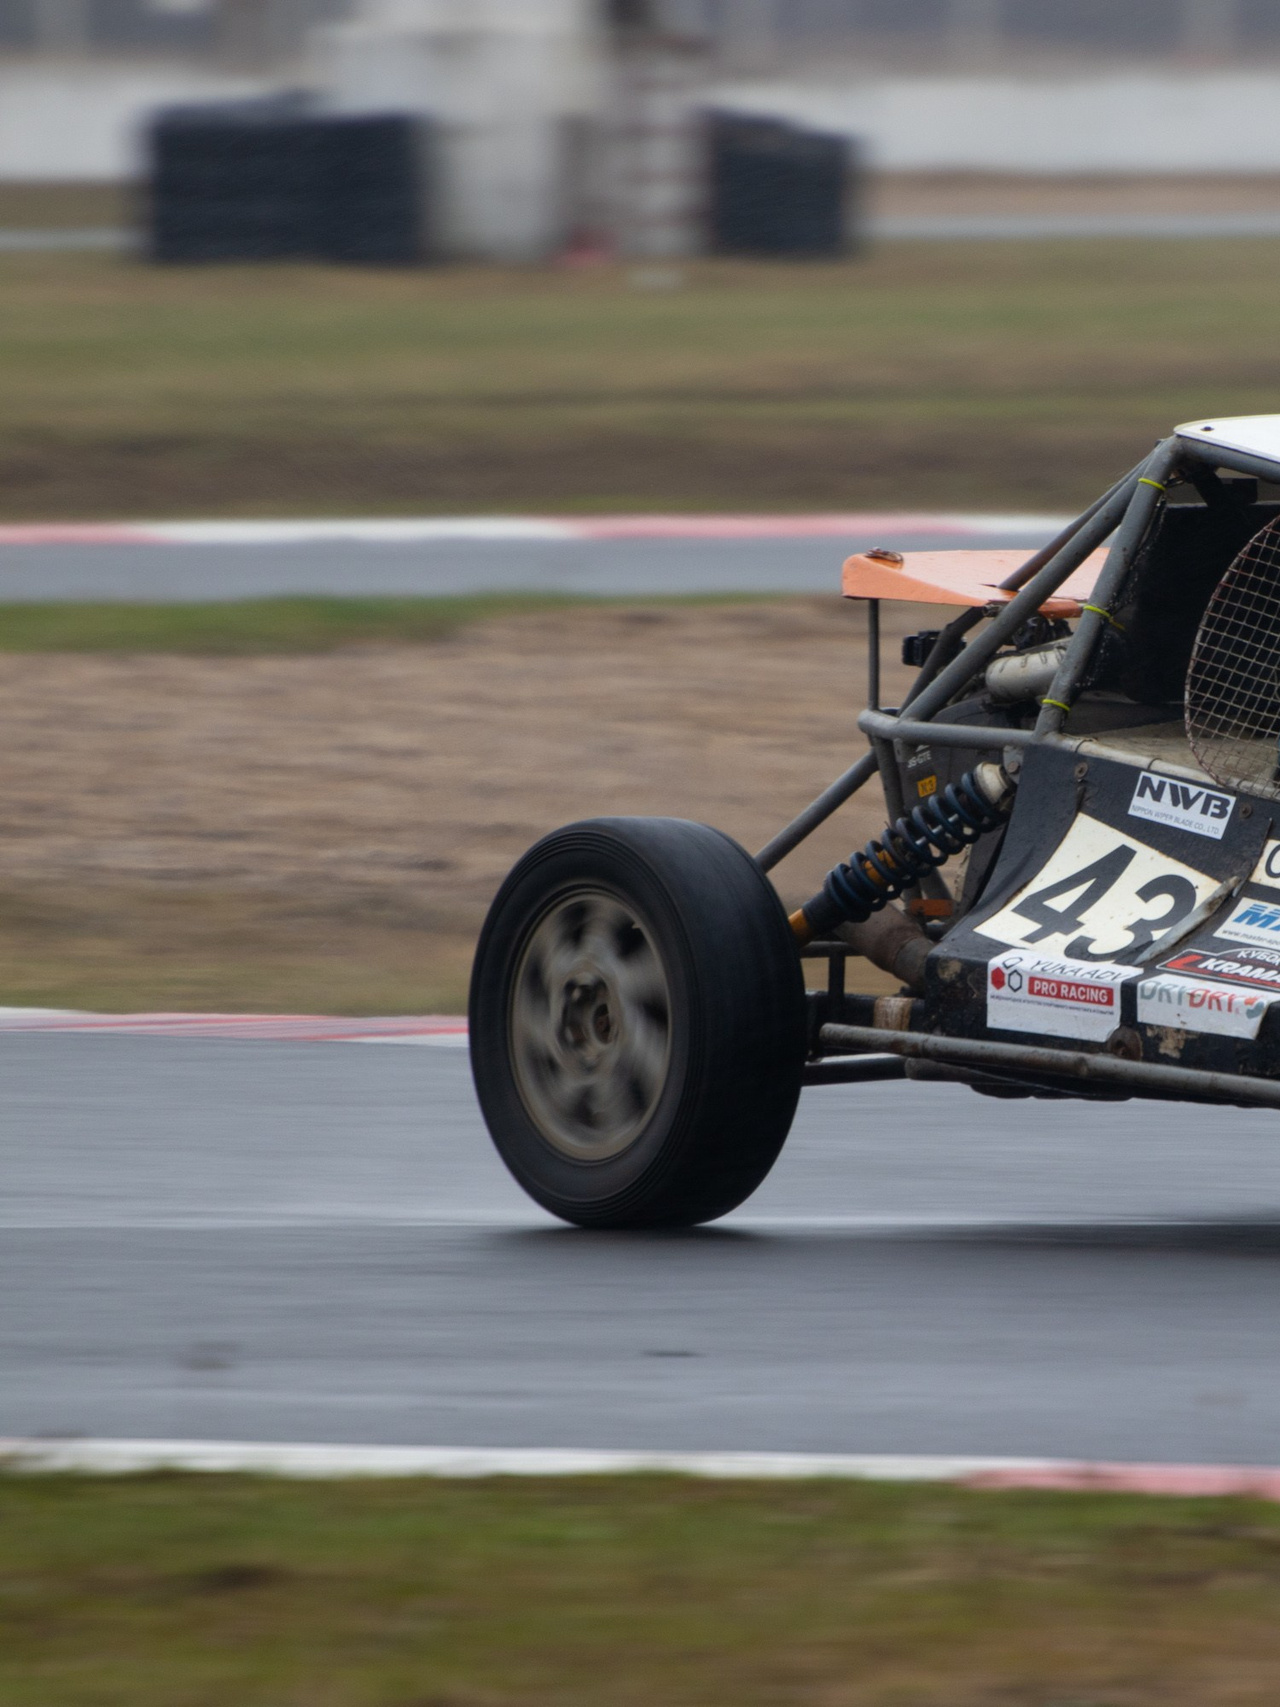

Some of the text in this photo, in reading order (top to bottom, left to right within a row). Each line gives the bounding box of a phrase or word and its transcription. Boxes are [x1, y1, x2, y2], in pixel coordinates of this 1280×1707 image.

[1136, 775, 1231, 819] NWB
[1131, 804, 1154, 818] NIPPON
[1154, 810, 1174, 823] WIPER
[1173, 815, 1194, 828] BLADE
[1010, 843, 1197, 964] 43
[1033, 980, 1109, 1003] PRO RACING
